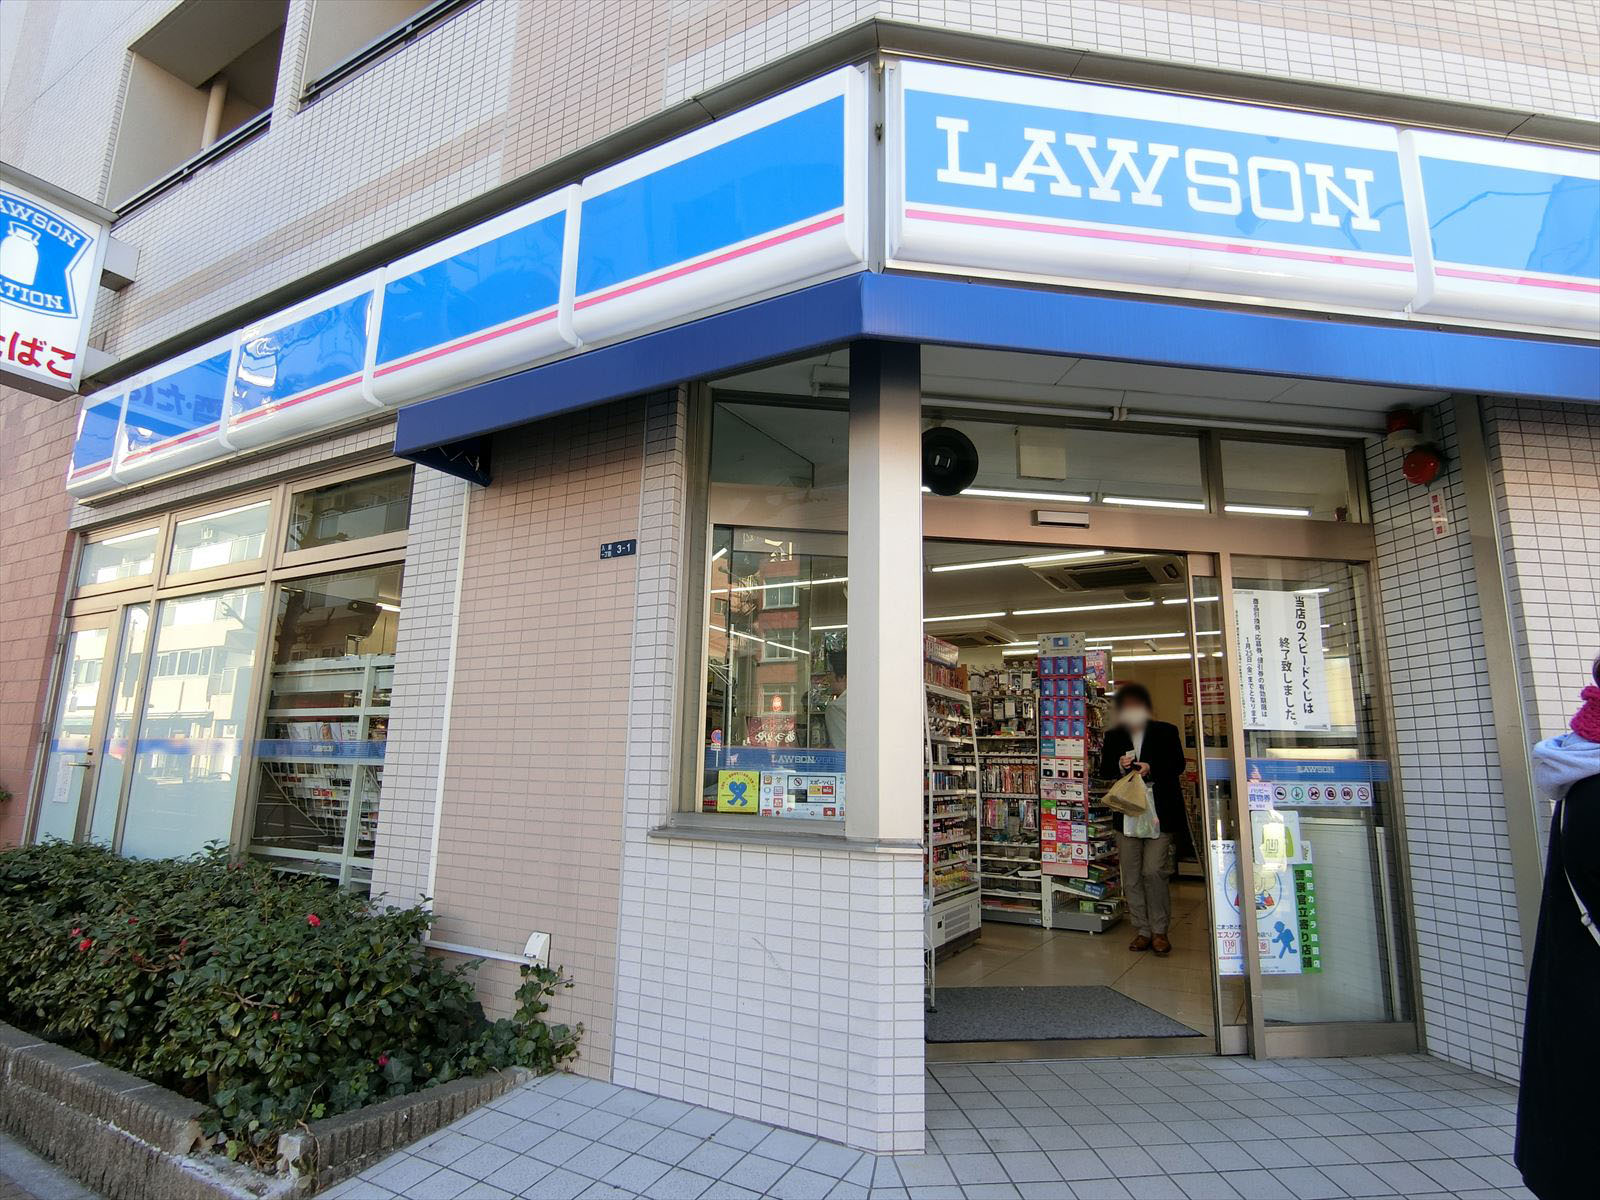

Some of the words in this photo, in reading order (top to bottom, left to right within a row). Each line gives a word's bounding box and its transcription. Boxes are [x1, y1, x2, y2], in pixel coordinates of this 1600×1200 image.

[935, 115, 1381, 232] LAWSON
[0, 331, 76, 379] ばこ
[616, 543, 631, 554] 3-1
[1279, 637, 1298, 727] 終了致しました。
[1294, 595, 1315, 714] 当店のスピードくじは
[771, 754, 816, 764] LAWSON
